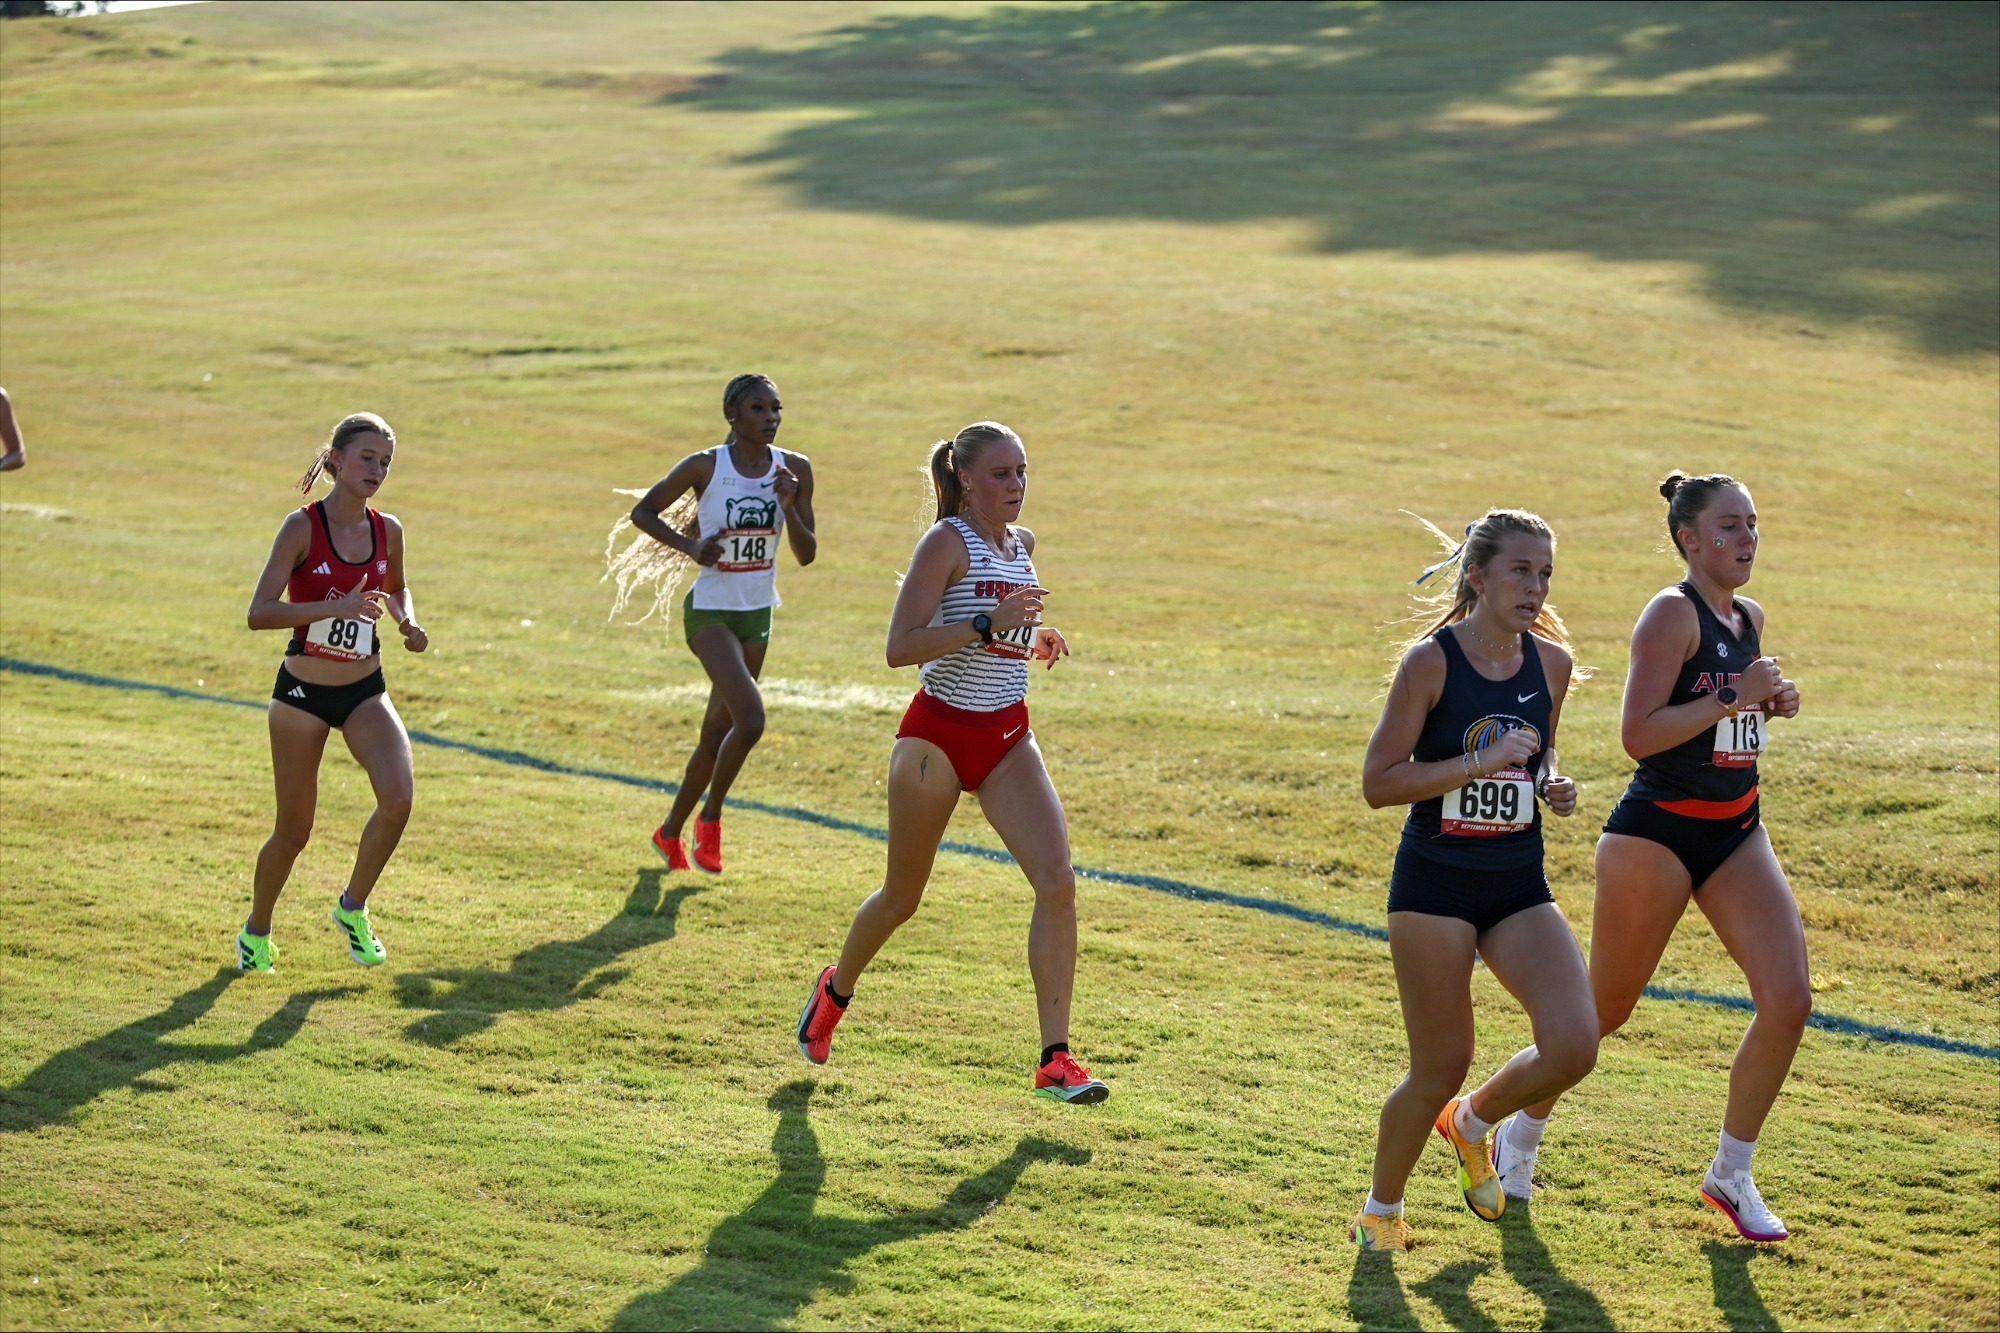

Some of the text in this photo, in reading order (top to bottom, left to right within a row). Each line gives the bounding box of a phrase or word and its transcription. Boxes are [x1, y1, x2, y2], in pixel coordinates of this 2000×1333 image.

[730, 537, 766, 561] 148
[328, 618, 359, 650] 89
[1730, 713, 1760, 750] 113
[1459, 781, 1519, 822] 699
